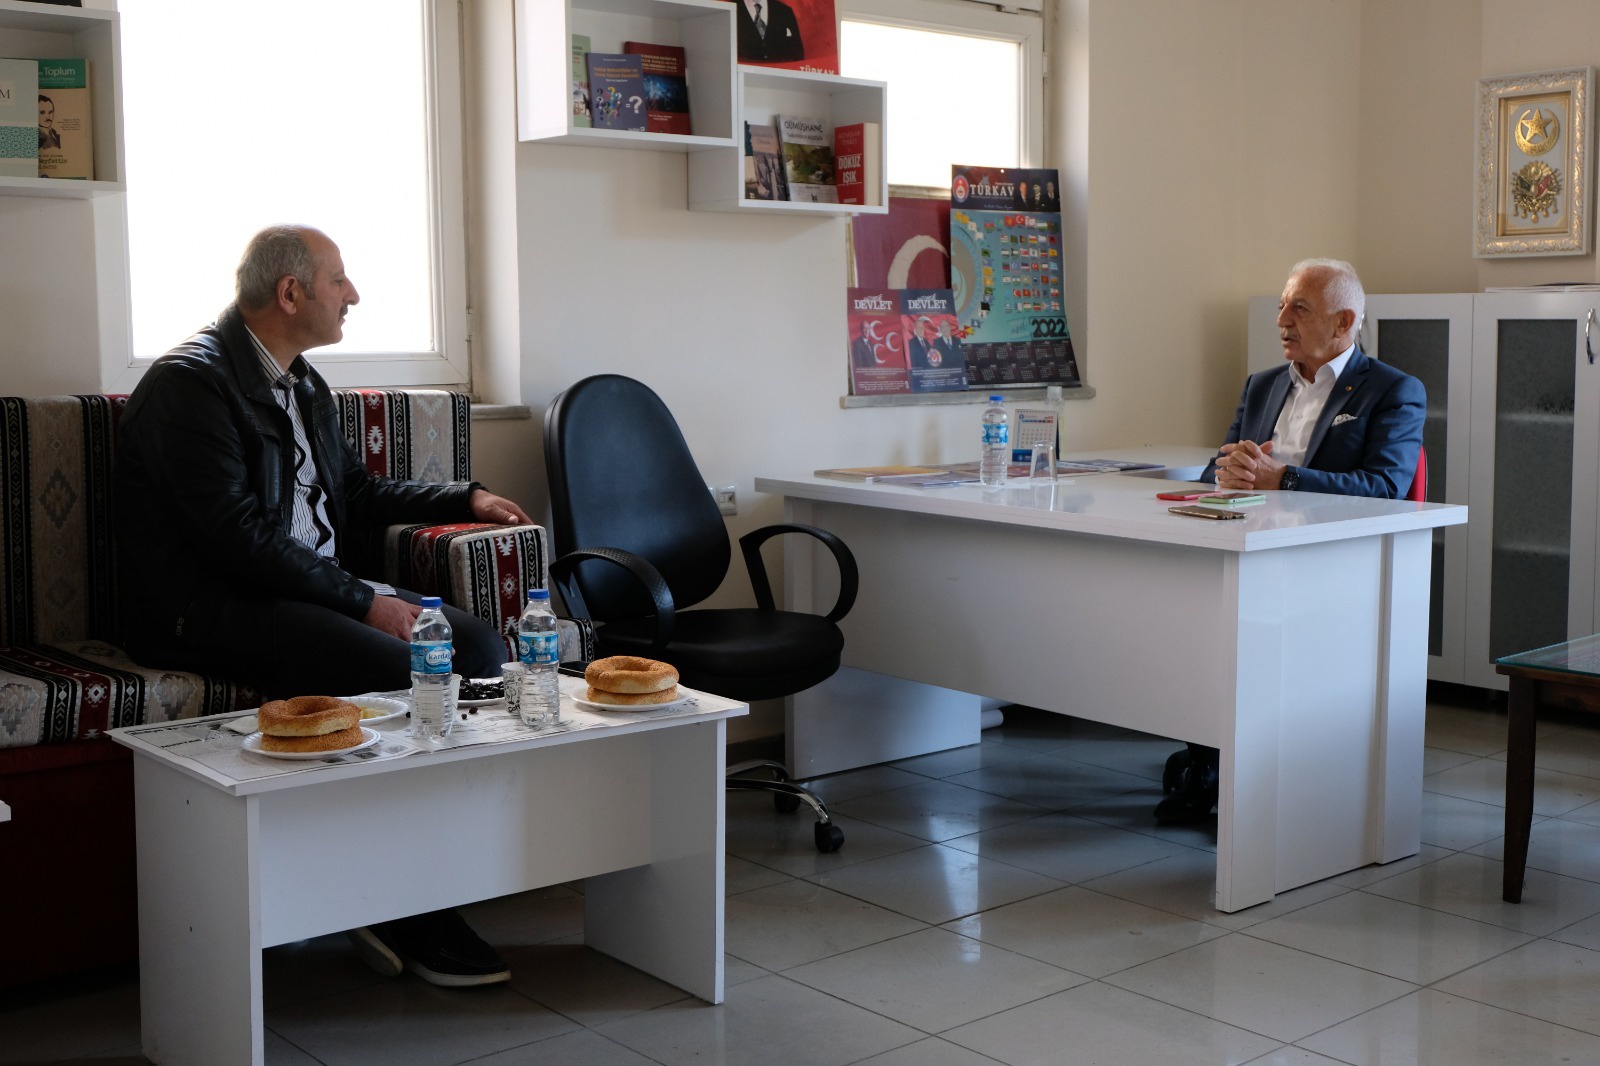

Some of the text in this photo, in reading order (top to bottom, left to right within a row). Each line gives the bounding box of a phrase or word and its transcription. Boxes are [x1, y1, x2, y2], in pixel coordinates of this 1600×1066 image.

[43, 67, 76, 77] Toplum
[838, 155, 861, 170] DOKUZ
[842, 171, 857, 186] IŞIK
[969, 182, 1015, 197] TÜRKAV
[853, 299, 893, 310] DEVLET
[907, 299, 947, 309] DEVLET
[1031, 318, 1067, 338] 2022
